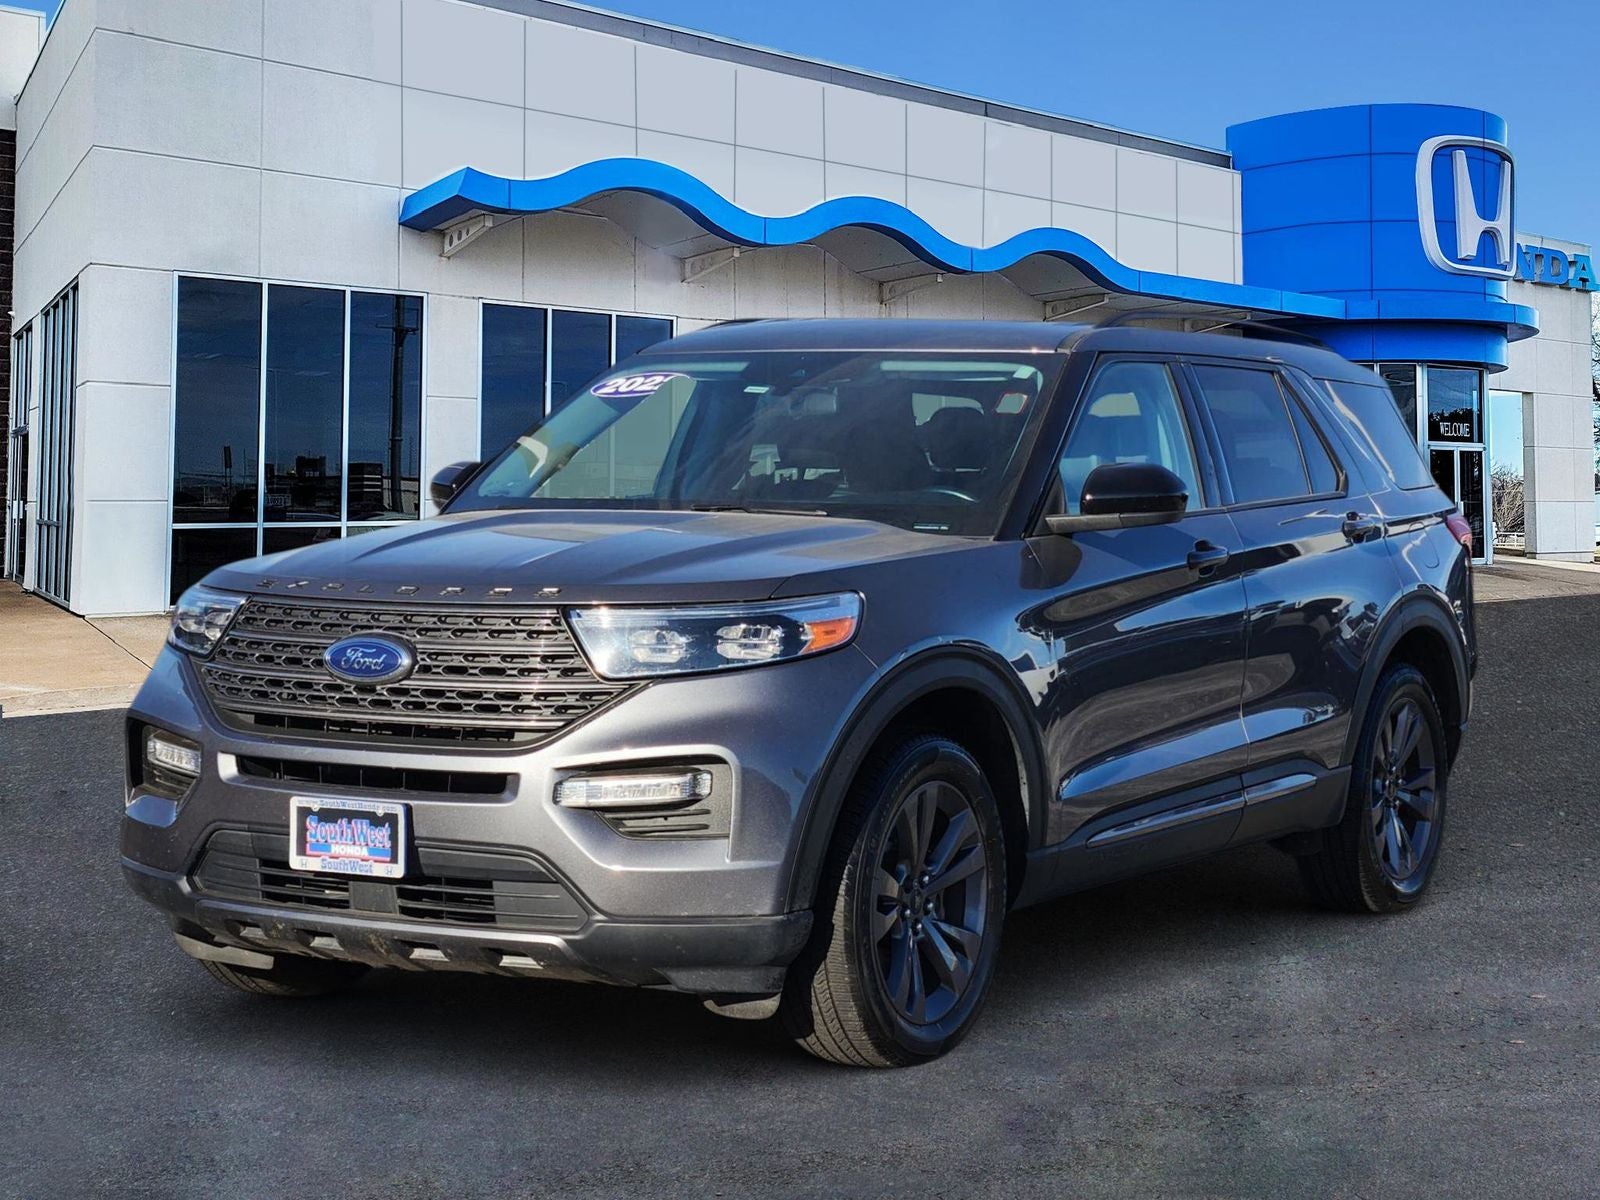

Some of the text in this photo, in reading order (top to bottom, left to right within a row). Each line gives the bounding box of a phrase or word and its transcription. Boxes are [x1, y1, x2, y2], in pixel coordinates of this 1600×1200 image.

[1516, 243, 1600, 291] NDA
[596, 375, 671, 394] 202
[1440, 422, 1471, 437] WELCOME
[341, 646, 387, 670] Ford
[306, 815, 391, 847] SouthWest
[330, 843, 369, 856] HONDA
[321, 859, 373, 874] SouthWest
